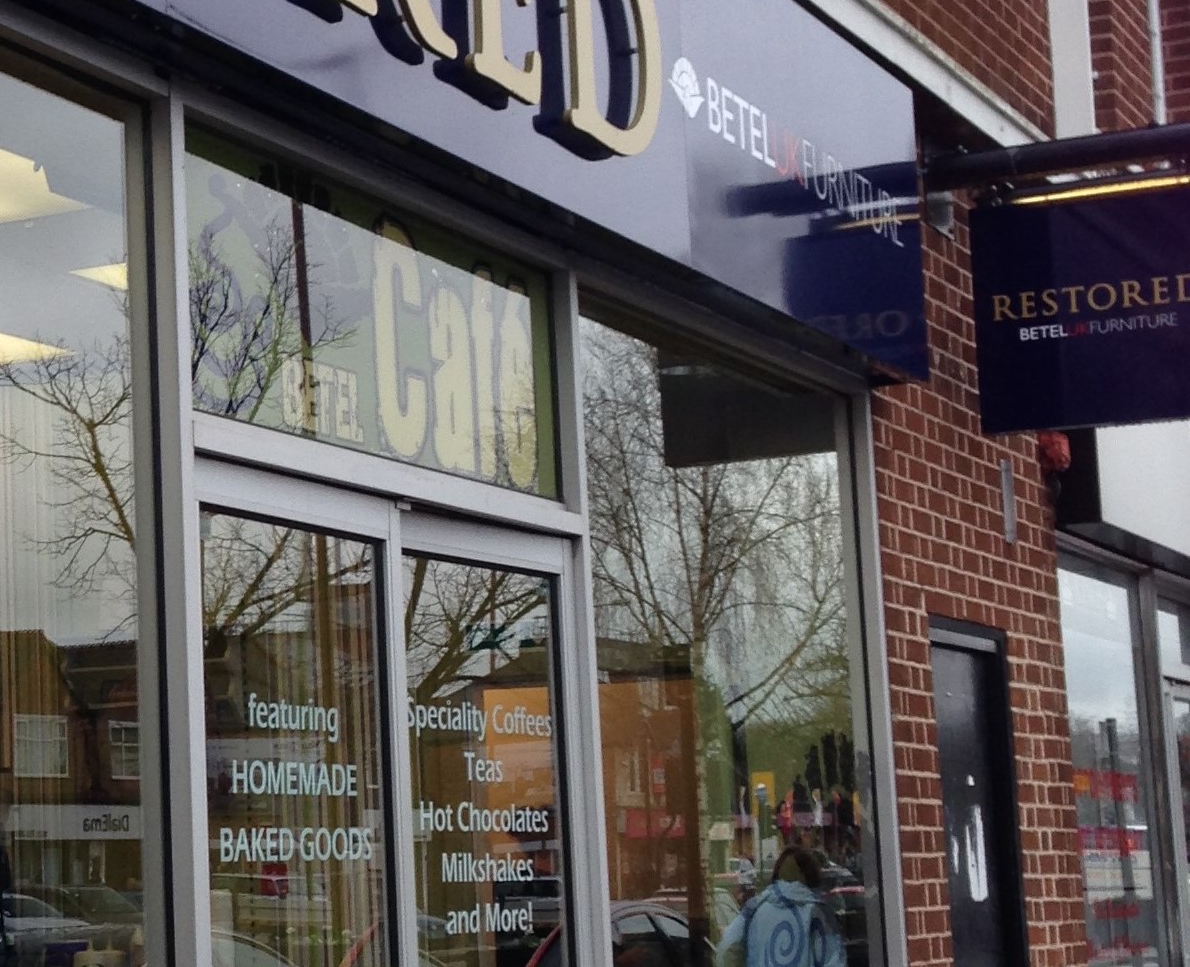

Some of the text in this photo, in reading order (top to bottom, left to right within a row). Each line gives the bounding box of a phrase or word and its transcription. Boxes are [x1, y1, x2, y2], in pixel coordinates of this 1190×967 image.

[248, 693, 338, 743] featuring
[492, 704, 552, 737] Coffees
[232, 760, 358, 797] HOMEMADE
[464, 752, 503, 782] Teas
[419, 801, 548, 833] Hot Chocolates
[220, 827, 372, 862] BAKED GOODS
[441, 853, 533, 883] Milkshakes
[447, 901, 533, 934] and More!
